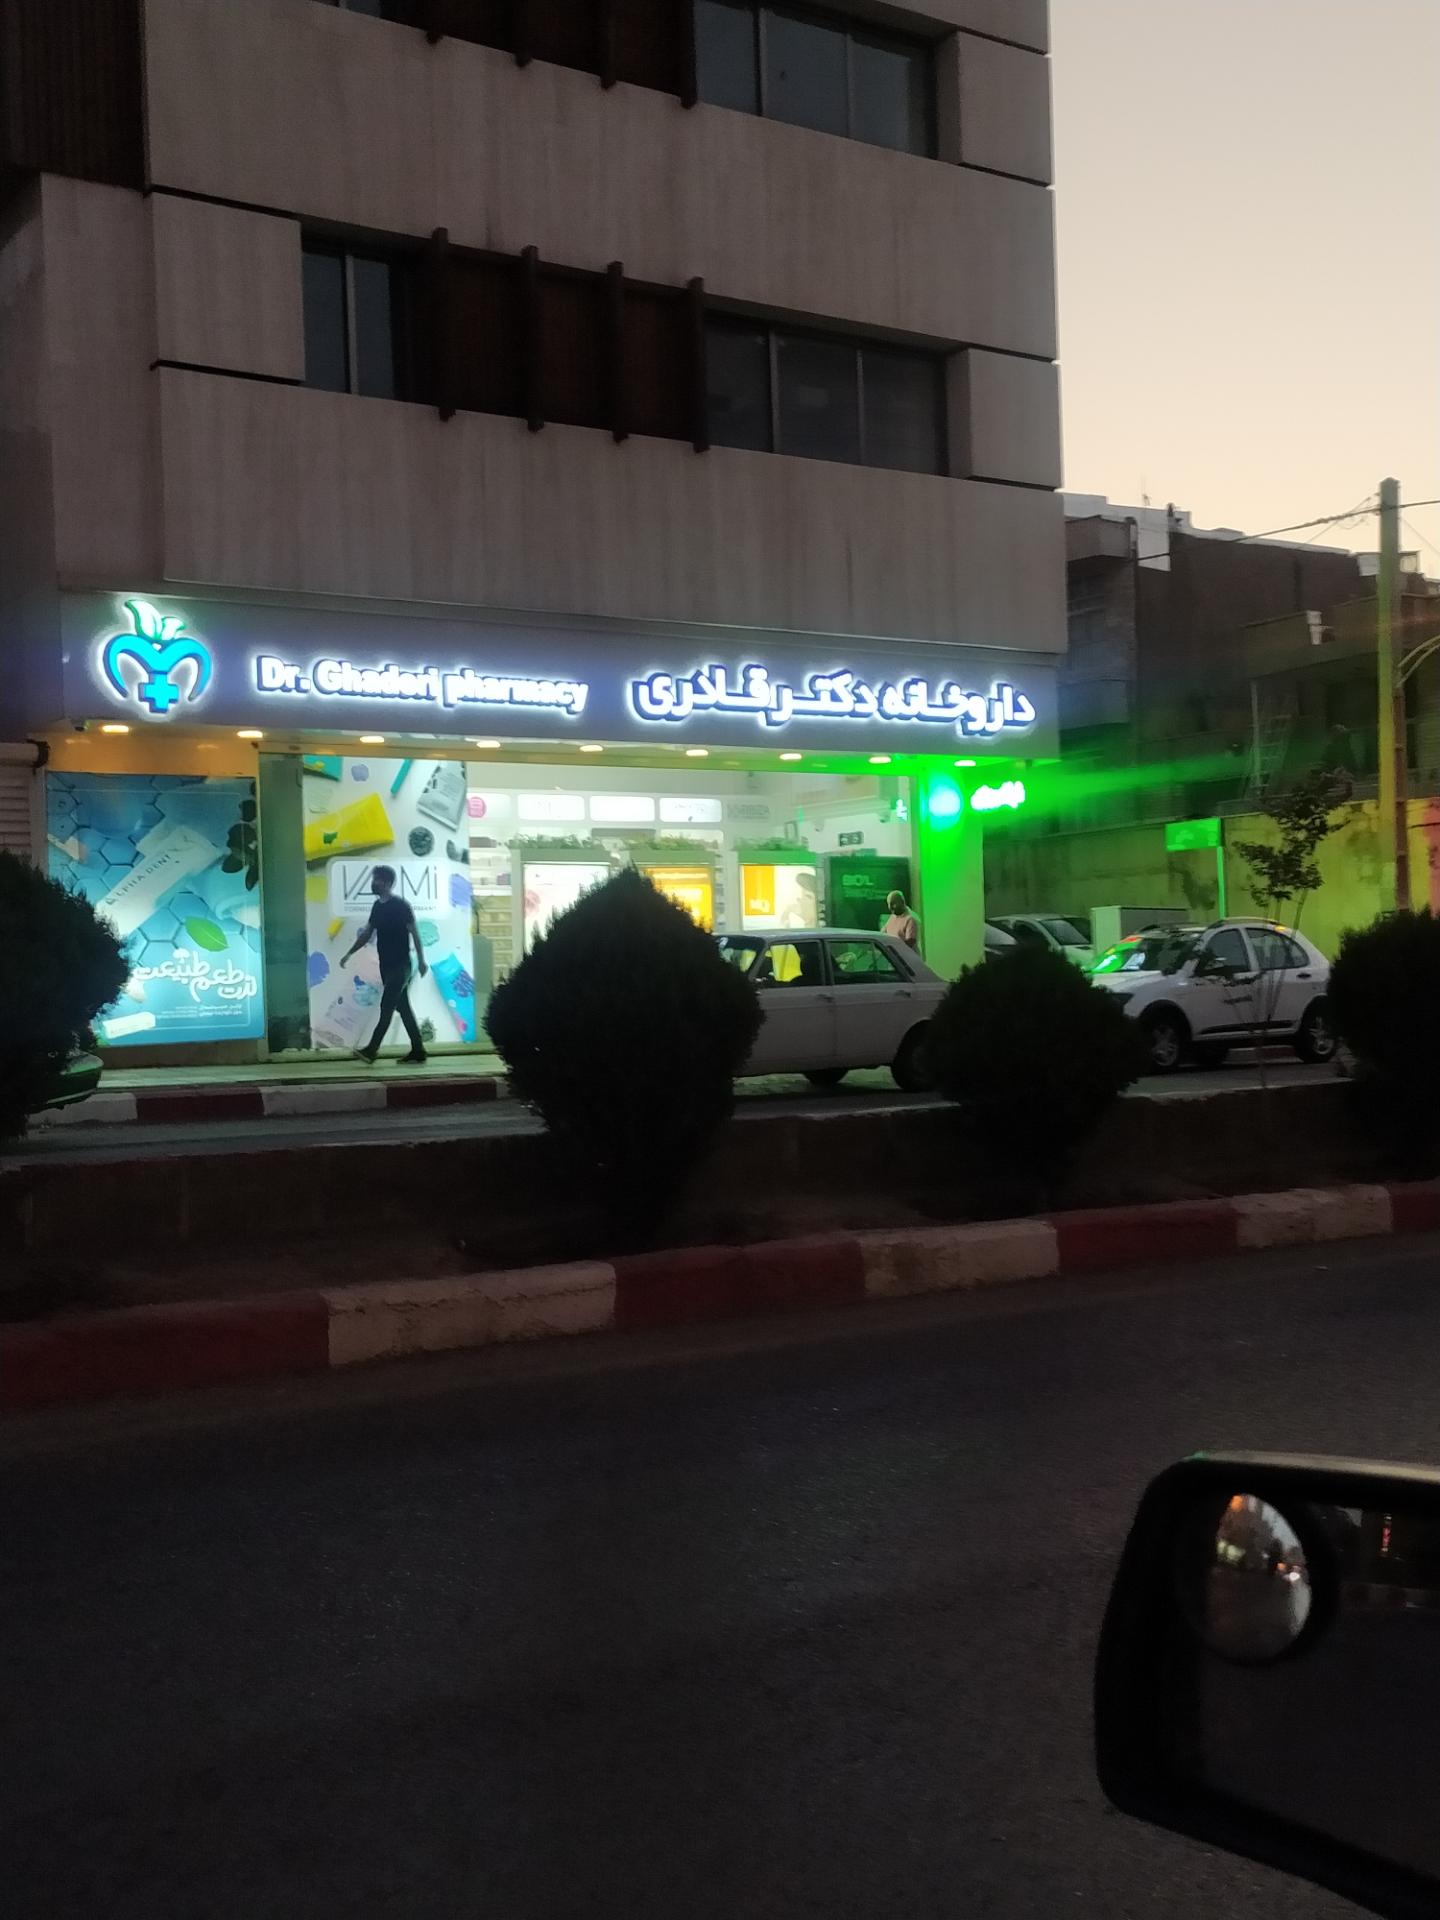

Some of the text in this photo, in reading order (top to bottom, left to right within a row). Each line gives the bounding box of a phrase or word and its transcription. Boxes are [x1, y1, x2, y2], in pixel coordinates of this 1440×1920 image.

[257, 655, 590, 715] Dr. Ghaderi pharmacy
[632, 664, 1036, 736] داروخانه دکتر قادری
